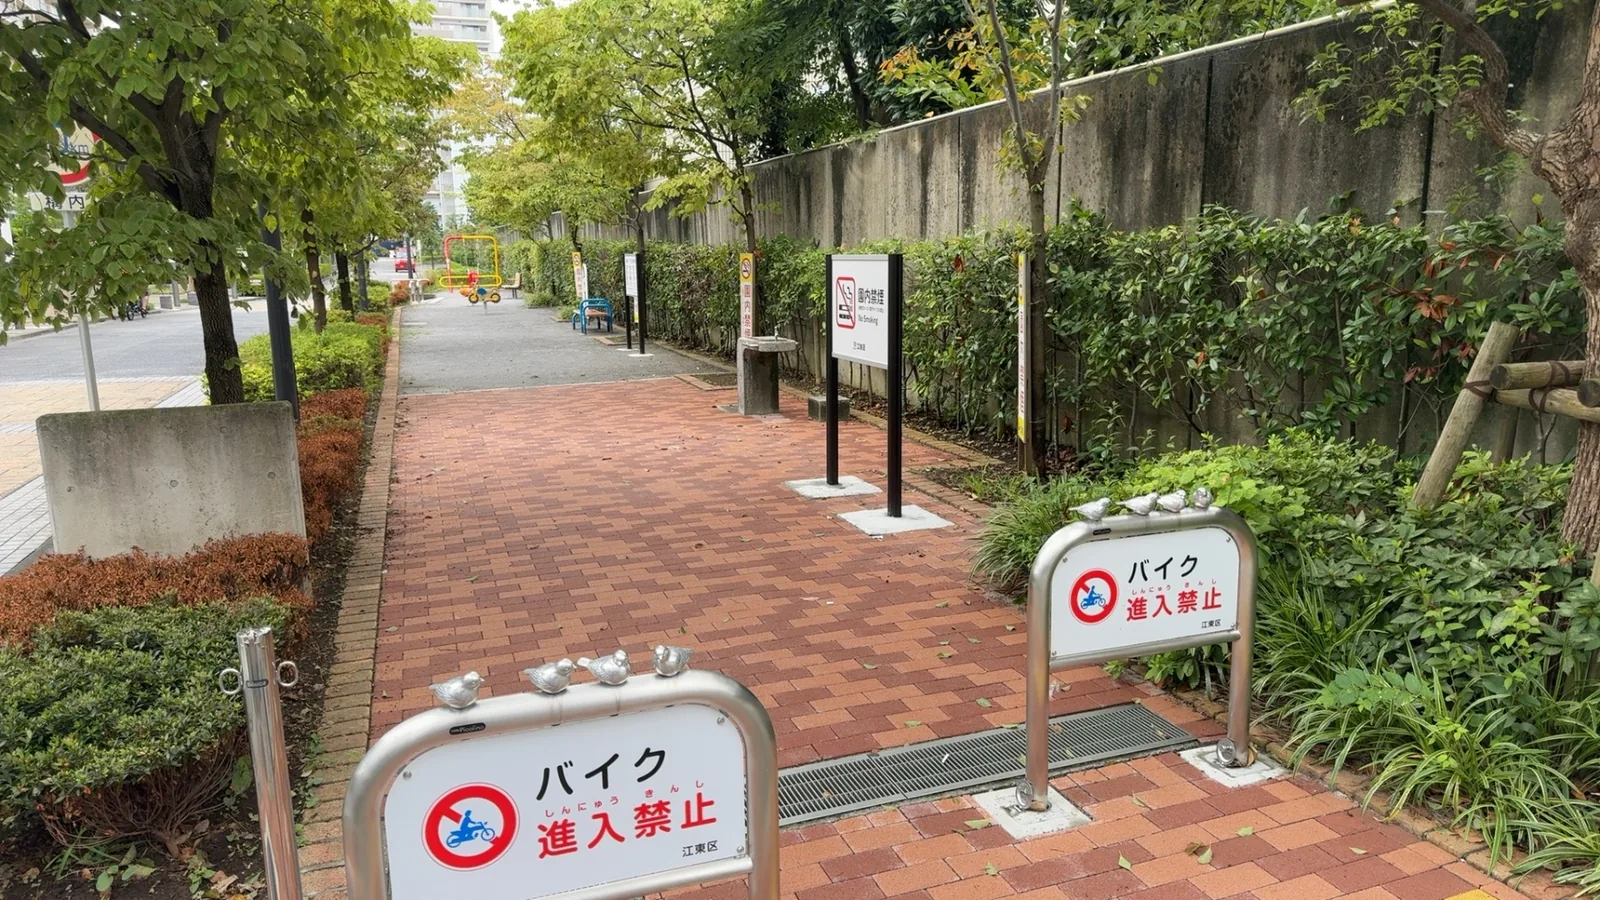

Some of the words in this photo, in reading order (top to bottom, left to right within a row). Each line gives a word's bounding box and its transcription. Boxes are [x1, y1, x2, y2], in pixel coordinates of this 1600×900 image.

[864, 315, 878, 326] Smoking
[1128, 555, 1198, 583] バイク
[1126, 586, 1222, 621] 進入禁止
[1132, 584, 1171, 595] しんにゅう
[1201, 619, 1222, 629] 江東区
[536, 747, 666, 800] バイク
[545, 796, 619, 818] しんにゅう
[645, 780, 704, 799] きんし
[537, 792, 717, 859] 進入禁止
[682, 840, 719, 857] 江東区
